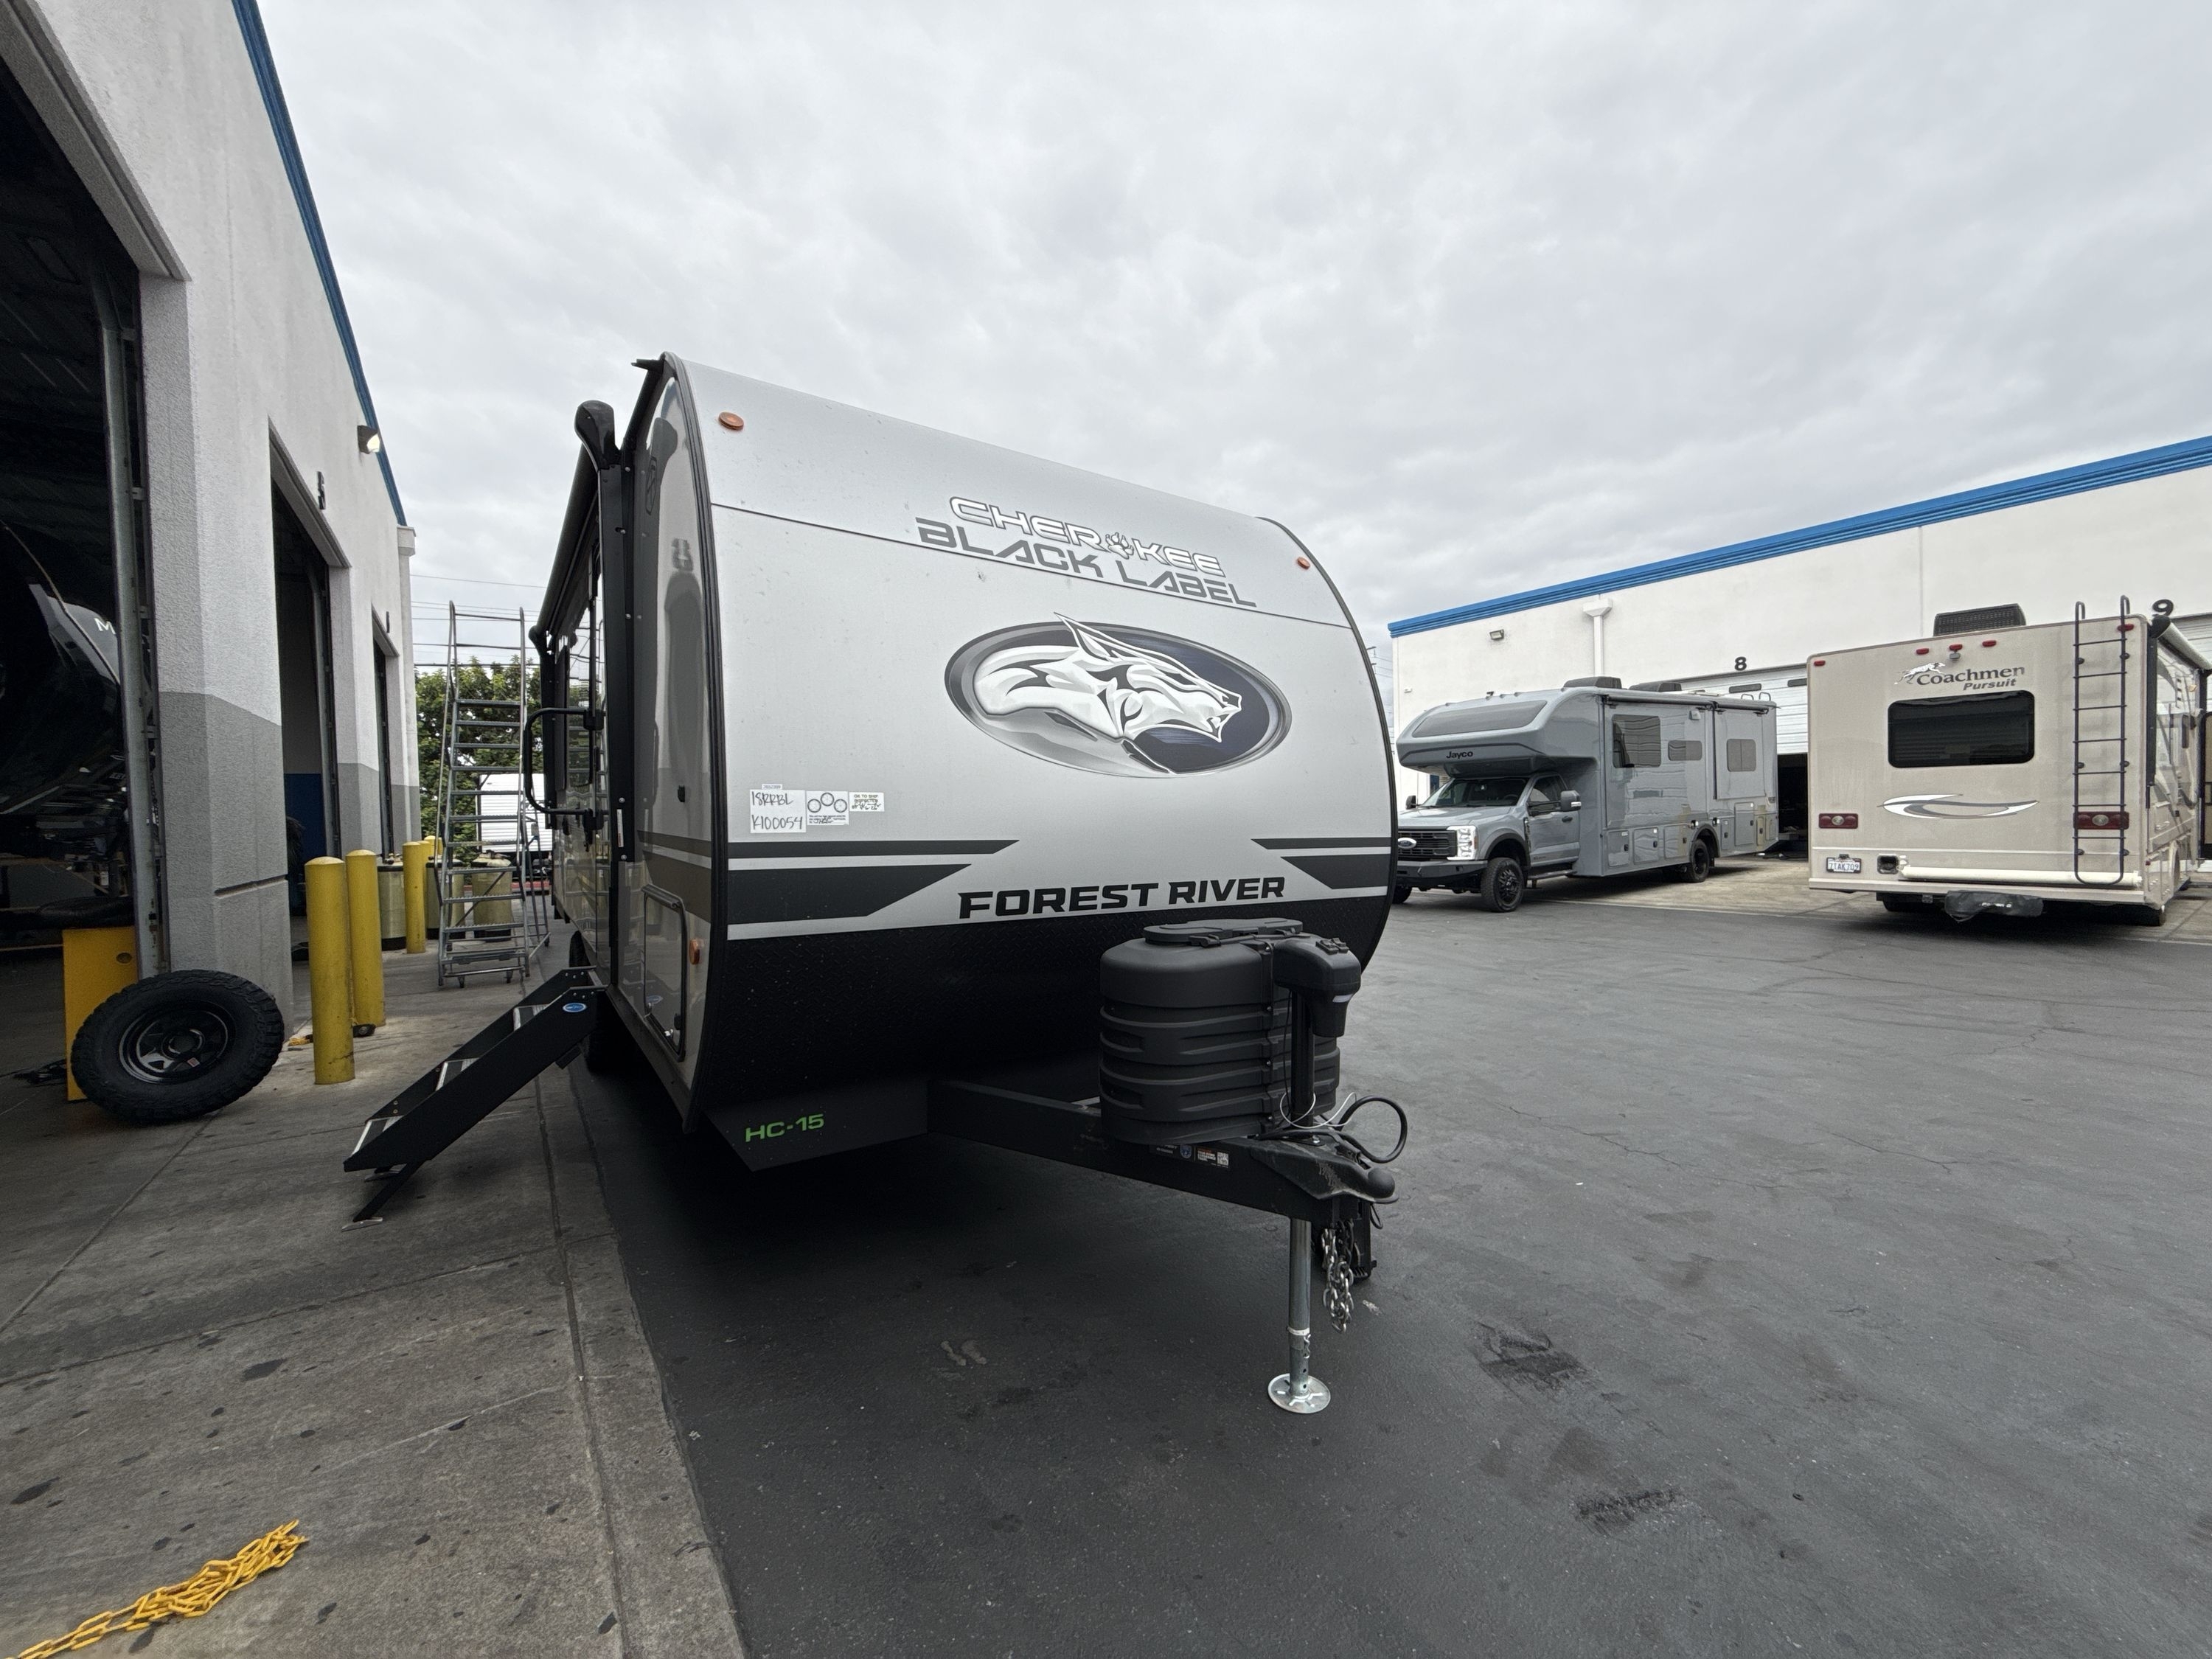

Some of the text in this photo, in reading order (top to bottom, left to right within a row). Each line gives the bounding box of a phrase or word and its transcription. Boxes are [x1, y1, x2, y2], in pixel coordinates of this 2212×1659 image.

[915, 517, 1257, 608] BLACK LABEL
[2152, 599, 2174, 617] 9
[1734, 656, 1747, 671] 8
[1917, 667, 2025, 686] Coachmen
[1963, 678, 2017, 690] Pursuit
[958, 877, 1284, 919] FOREST RIVER
[745, 1114, 824, 1142] HC-15
